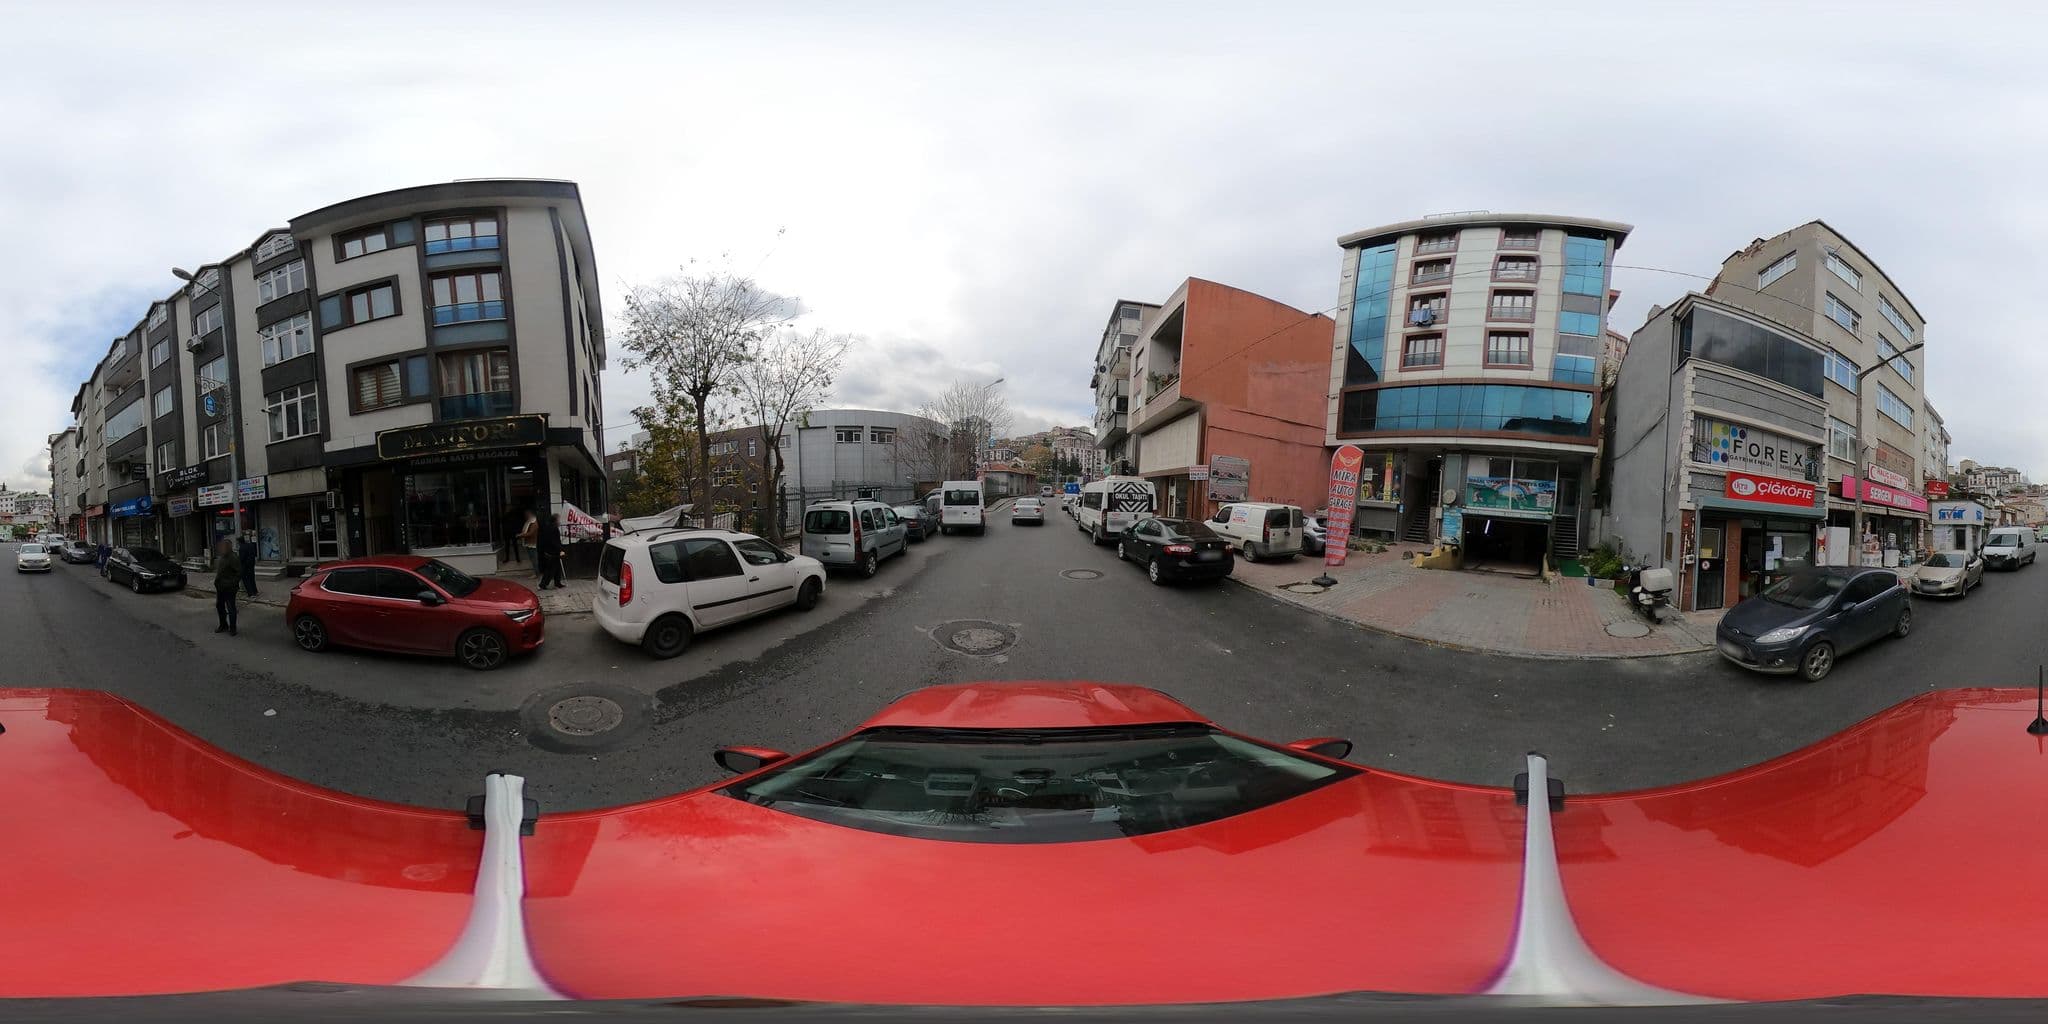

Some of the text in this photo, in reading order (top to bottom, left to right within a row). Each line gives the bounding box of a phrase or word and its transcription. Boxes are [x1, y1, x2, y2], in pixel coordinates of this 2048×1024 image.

[1733, 440, 1802, 467] FOREX
[1331, 485, 1354, 496] AUTO
[1758, 481, 1812, 499] ÇİĞKÖFTE
[1329, 497, 1352, 510] GARAGE
